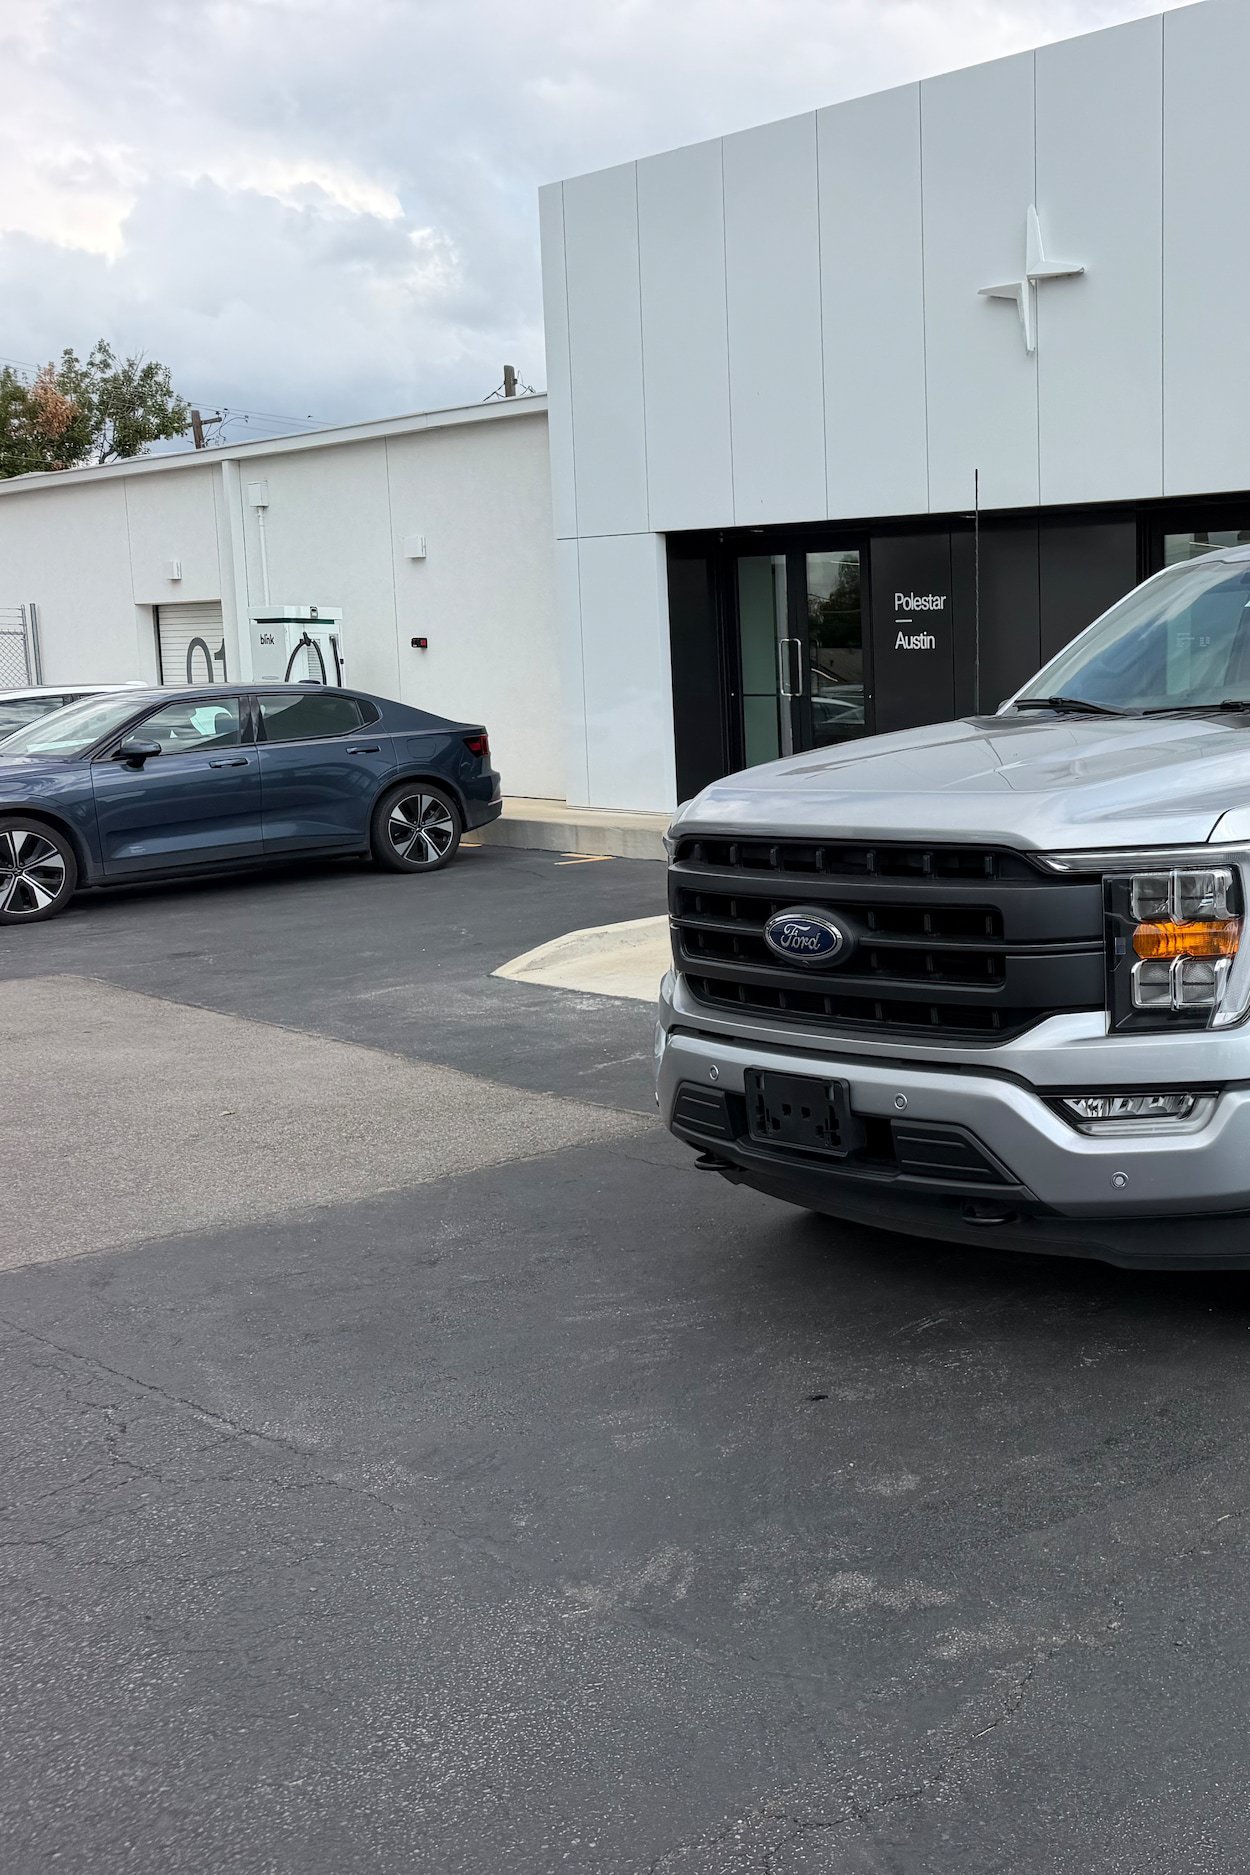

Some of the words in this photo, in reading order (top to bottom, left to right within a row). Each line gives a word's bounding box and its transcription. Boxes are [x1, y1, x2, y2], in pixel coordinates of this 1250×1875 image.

[895, 592, 946, 610] Polestar
[260, 634, 275, 645] blink
[895, 631, 935, 649] Austin
[781, 923, 821, 950] Ford
